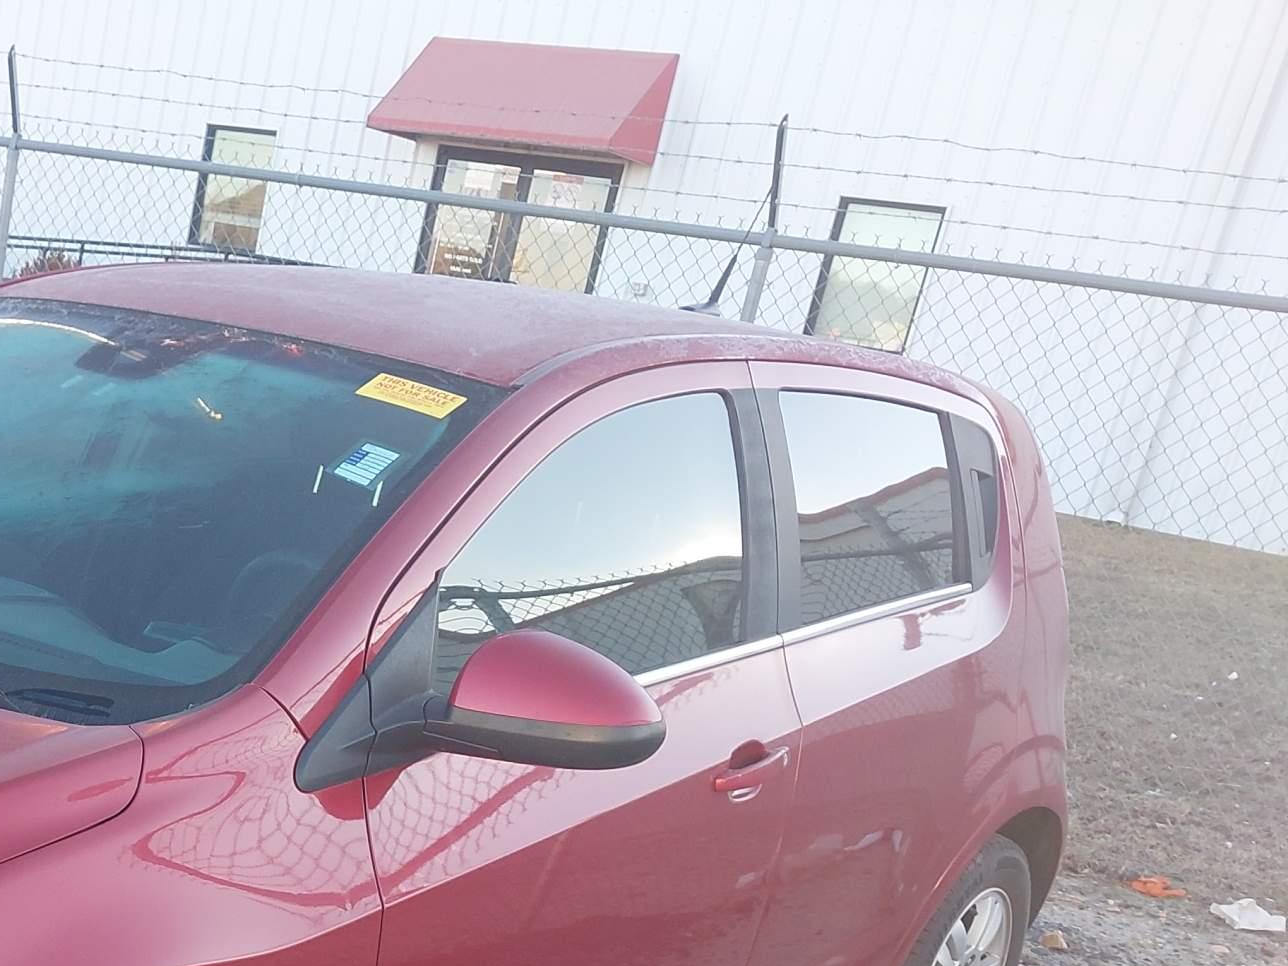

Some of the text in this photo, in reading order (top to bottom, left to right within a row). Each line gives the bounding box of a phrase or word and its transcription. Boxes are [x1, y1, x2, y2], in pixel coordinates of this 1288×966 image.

[375, 381, 396, 391] NOT
[398, 387, 421, 397] FOR
[423, 394, 451, 406] SALE
[381, 375, 408, 387] THIS
[410, 383, 459, 402] VEHICLE
